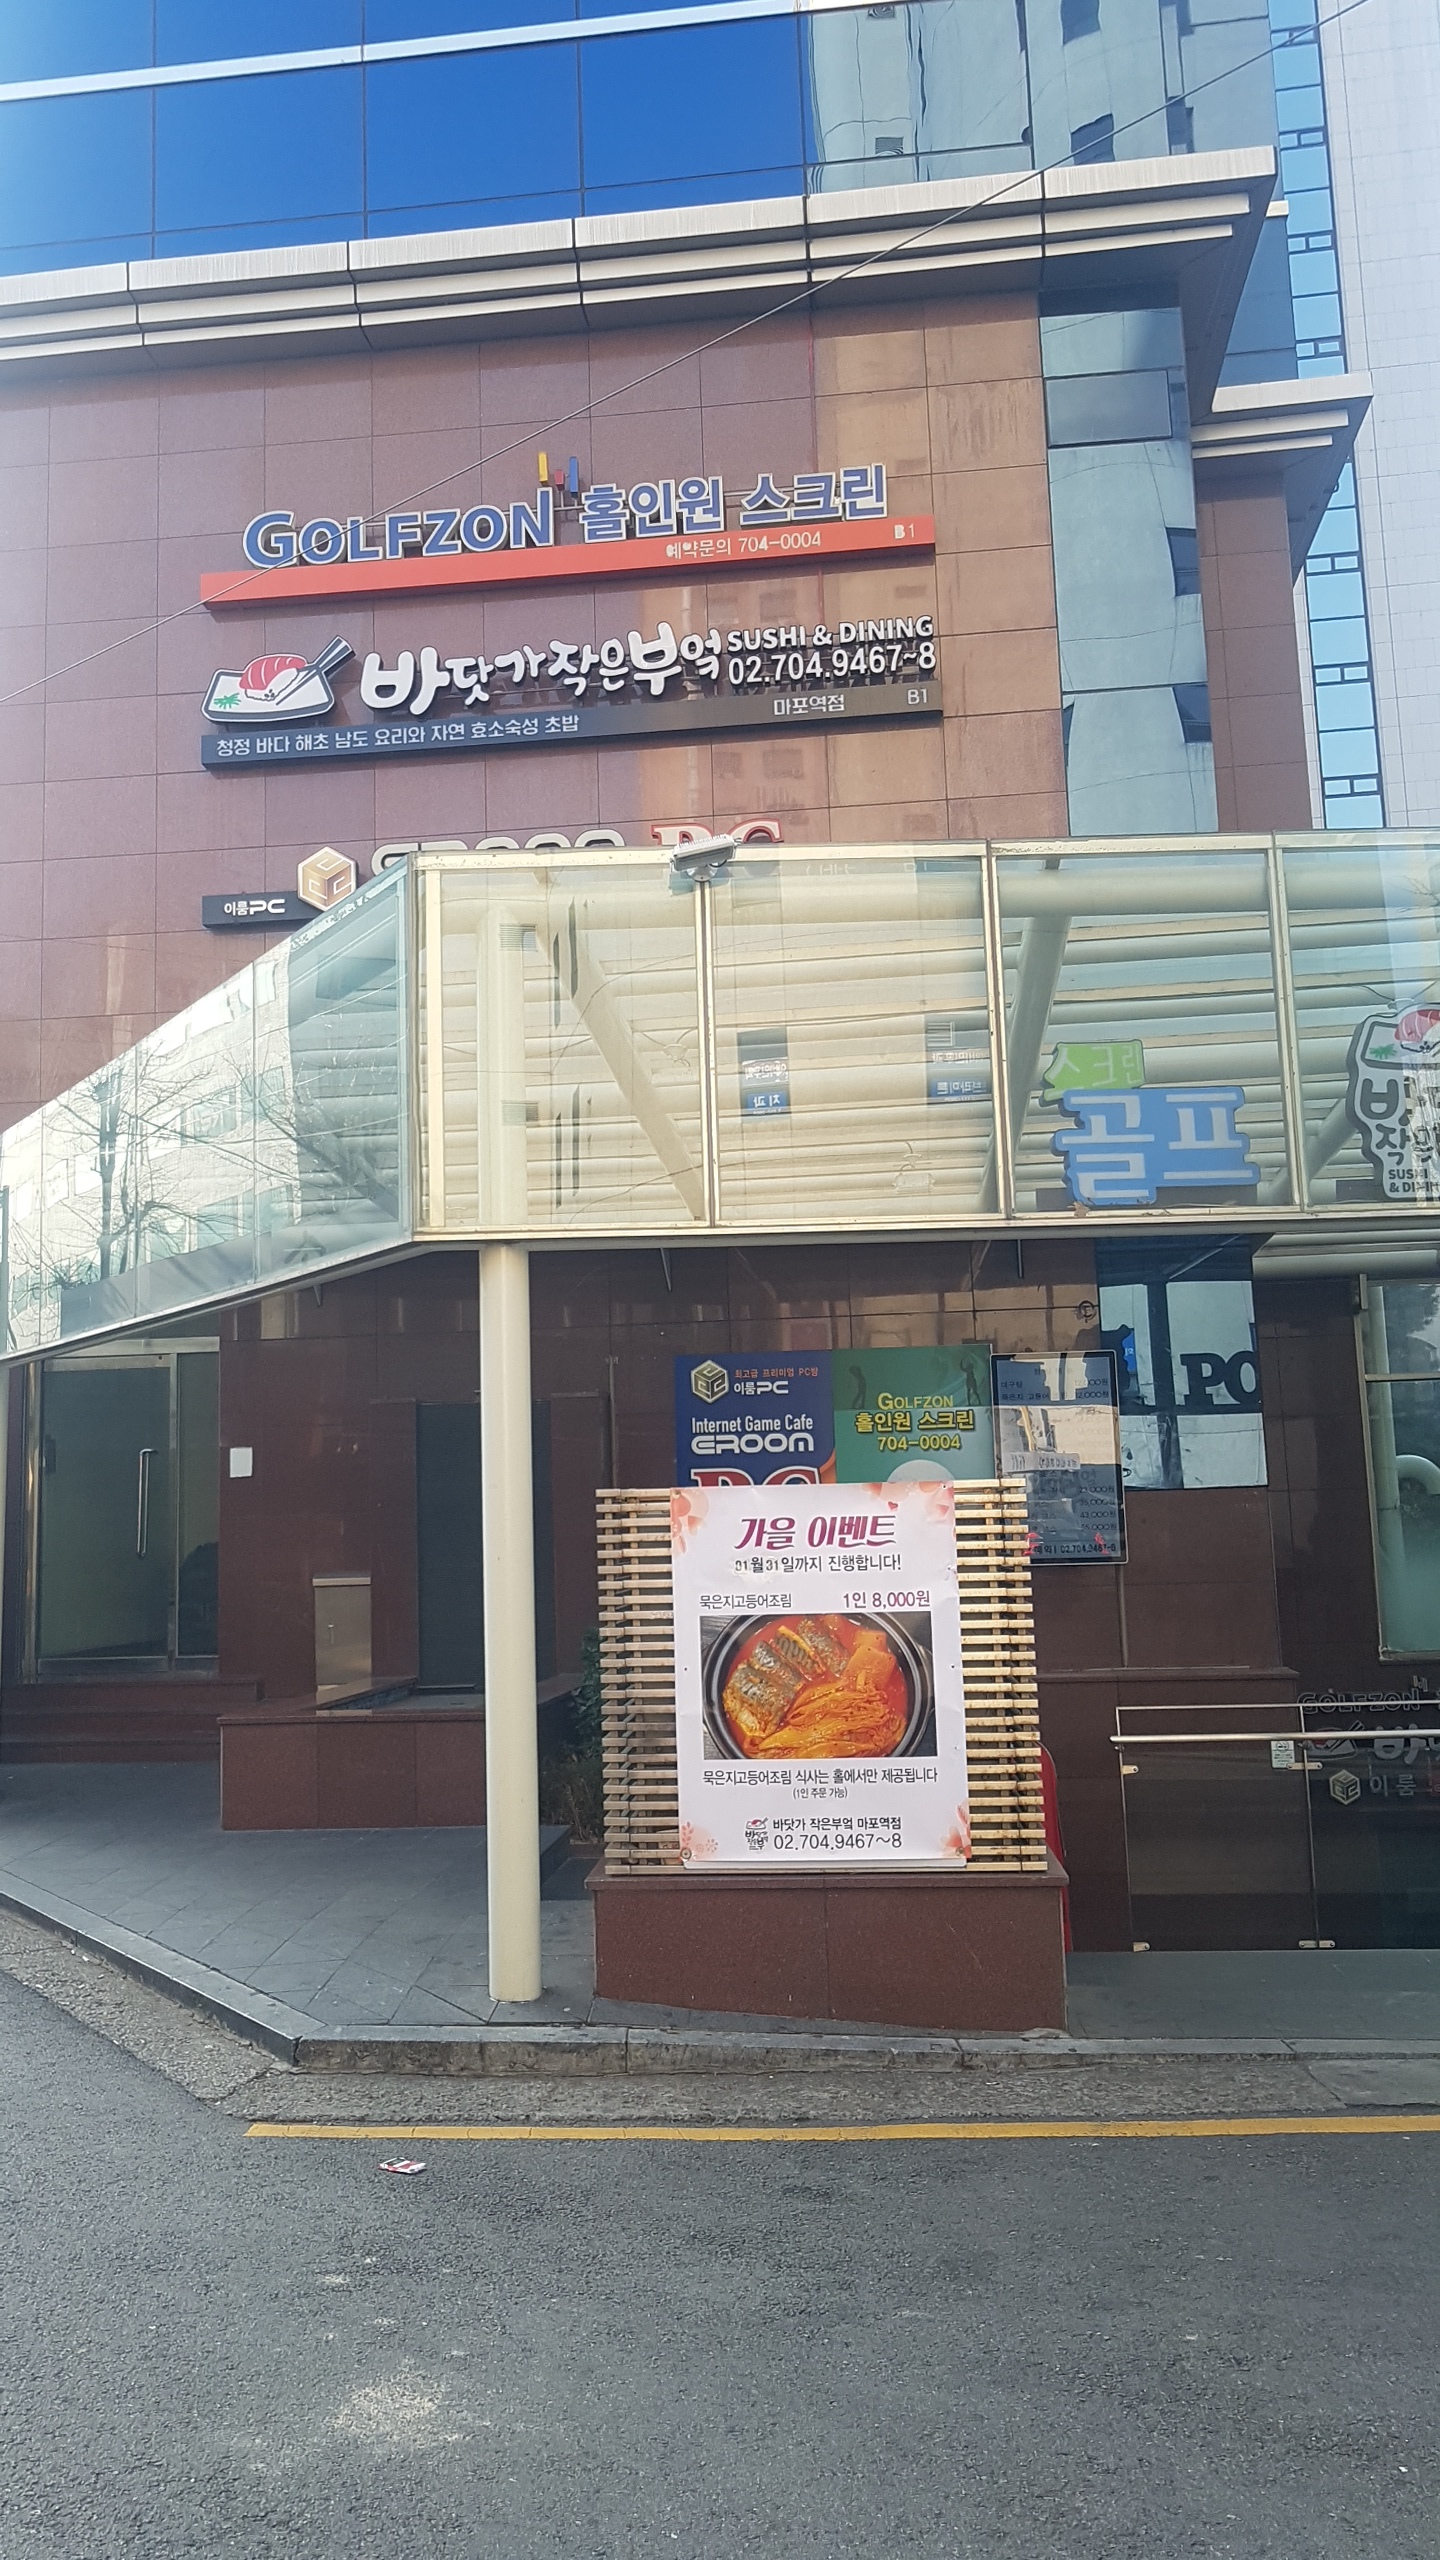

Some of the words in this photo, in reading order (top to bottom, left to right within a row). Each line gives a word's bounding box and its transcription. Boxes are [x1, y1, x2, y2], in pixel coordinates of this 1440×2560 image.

[243, 487, 553, 569] GOLFZON
[579, 476, 725, 543] 홀인원
[739, 463, 888, 528] 스크린
[893, 524, 917, 539] B1
[666, 538, 732, 559] 예약문의
[738, 532, 822, 553] 704-0004
[727, 625, 805, 653] SUSHI
[812, 624, 832, 646] &
[838, 615, 935, 644] DINING
[727, 641, 937, 686] 02.704.9467~8
[773, 694, 845, 717] 마포역점
[907, 688, 928, 705] B1
[216, 738, 251, 757] 청정
[255, 735, 291, 754] 바다
[295, 733, 329, 752] 해초
[334, 731, 369, 749] 남도
[374, 726, 426, 747] 요리와
[430, 723, 466, 743] 자연
[470, 719, 539, 740] 효소숙성
[544, 714, 580, 733] 초밥
[223, 898, 286, 917] 이룸PC
[1061, 1092, 1254, 1199] 골프
[1388, 1168, 1428, 1180] SUSI
[1389, 1182, 1400, 1193] &
[734, 1369, 758, 1379] 최고급
[763, 1367, 794, 1378] 프리미엄
[798, 1366, 819, 1377] PC방
[733, 1380, 789, 1396] 이룸PC
[877, 1392, 954, 1410] GOLFZON
[691, 1416, 742, 1434] Internet
[744, 1415, 781, 1432] Game
[785, 1413, 813, 1431] Cafe
[855, 1411, 911, 1433] 홀인원
[918, 1409, 974, 1431] 스크린
[690, 1432, 814, 1455] EROOM
[876, 1434, 961, 1451] 704-0004
[733, 1516, 796, 1551] 가을
[807, 1514, 897, 1549] 이벤트
[828, 1553, 901, 1572] 진행합니다!
[700, 1593, 792, 1610] 묵은지고등어조림
[842, 1592, 867, 1609] 1인
[871, 1589, 931, 1608] 8,000원
[703, 1770, 792, 1785] 묵은지고등어조림
[795, 1769, 829, 1784] 식사는
[832, 1768, 878, 1784] 홀에서만
[881, 1767, 938, 1783] 제공됩니다
[793, 1787, 809, 1799] (1인
[811, 1788, 827, 1798] 주문
[829, 1786, 848, 1798] 가능)
[773, 1818, 806, 1831] 바닷가
[809, 1817, 853, 1831] 작은부엌
[857, 1817, 902, 1830] 마포역점
[773, 1833, 902, 1850] 02.704.9467~8
